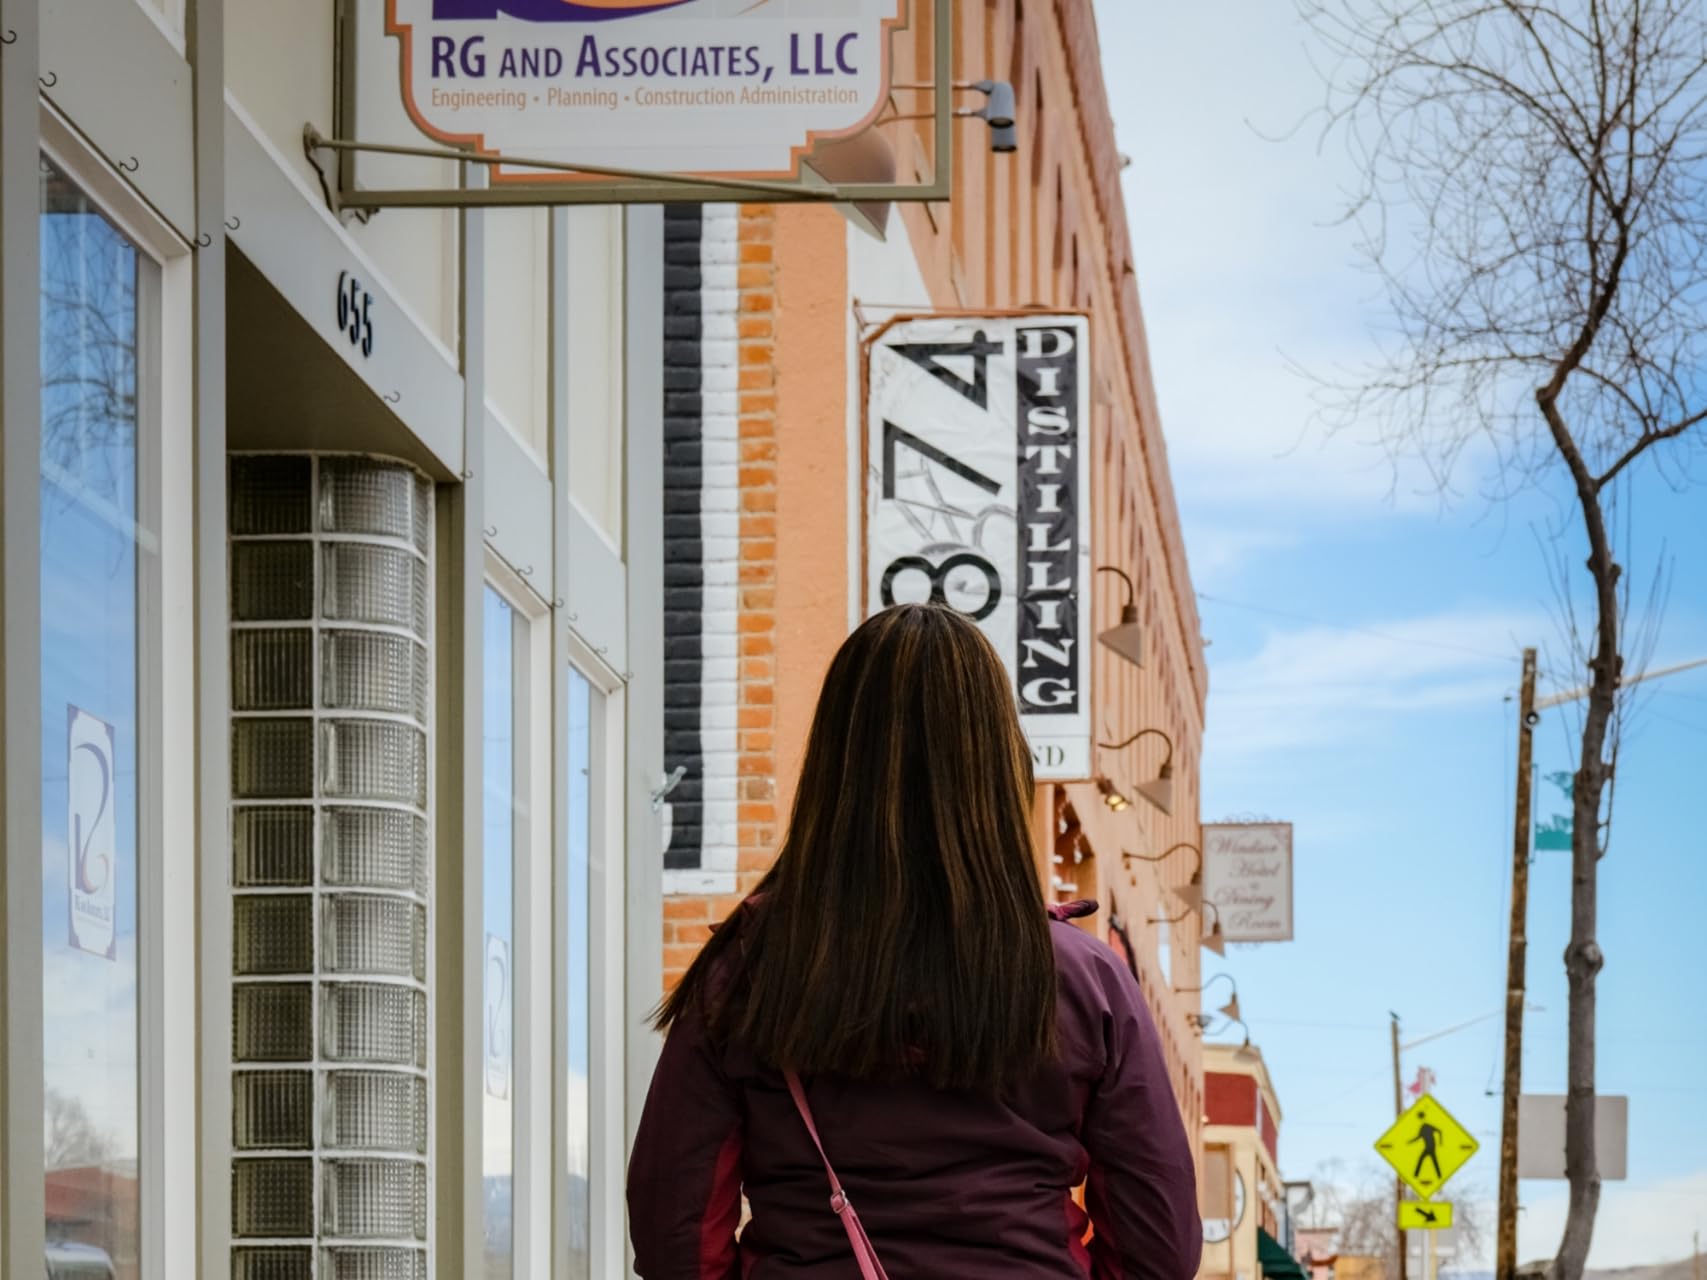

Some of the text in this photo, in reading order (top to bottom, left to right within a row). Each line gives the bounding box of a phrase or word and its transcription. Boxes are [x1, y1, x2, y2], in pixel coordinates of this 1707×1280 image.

[431, 32, 859, 84] RG AND ASSOCIATES, LLC
[431, 84, 859, 112] Engineering Planning Construction Administration
[337, 269, 374, 358] 655
[1021, 329, 1078, 707] DISTILLING
